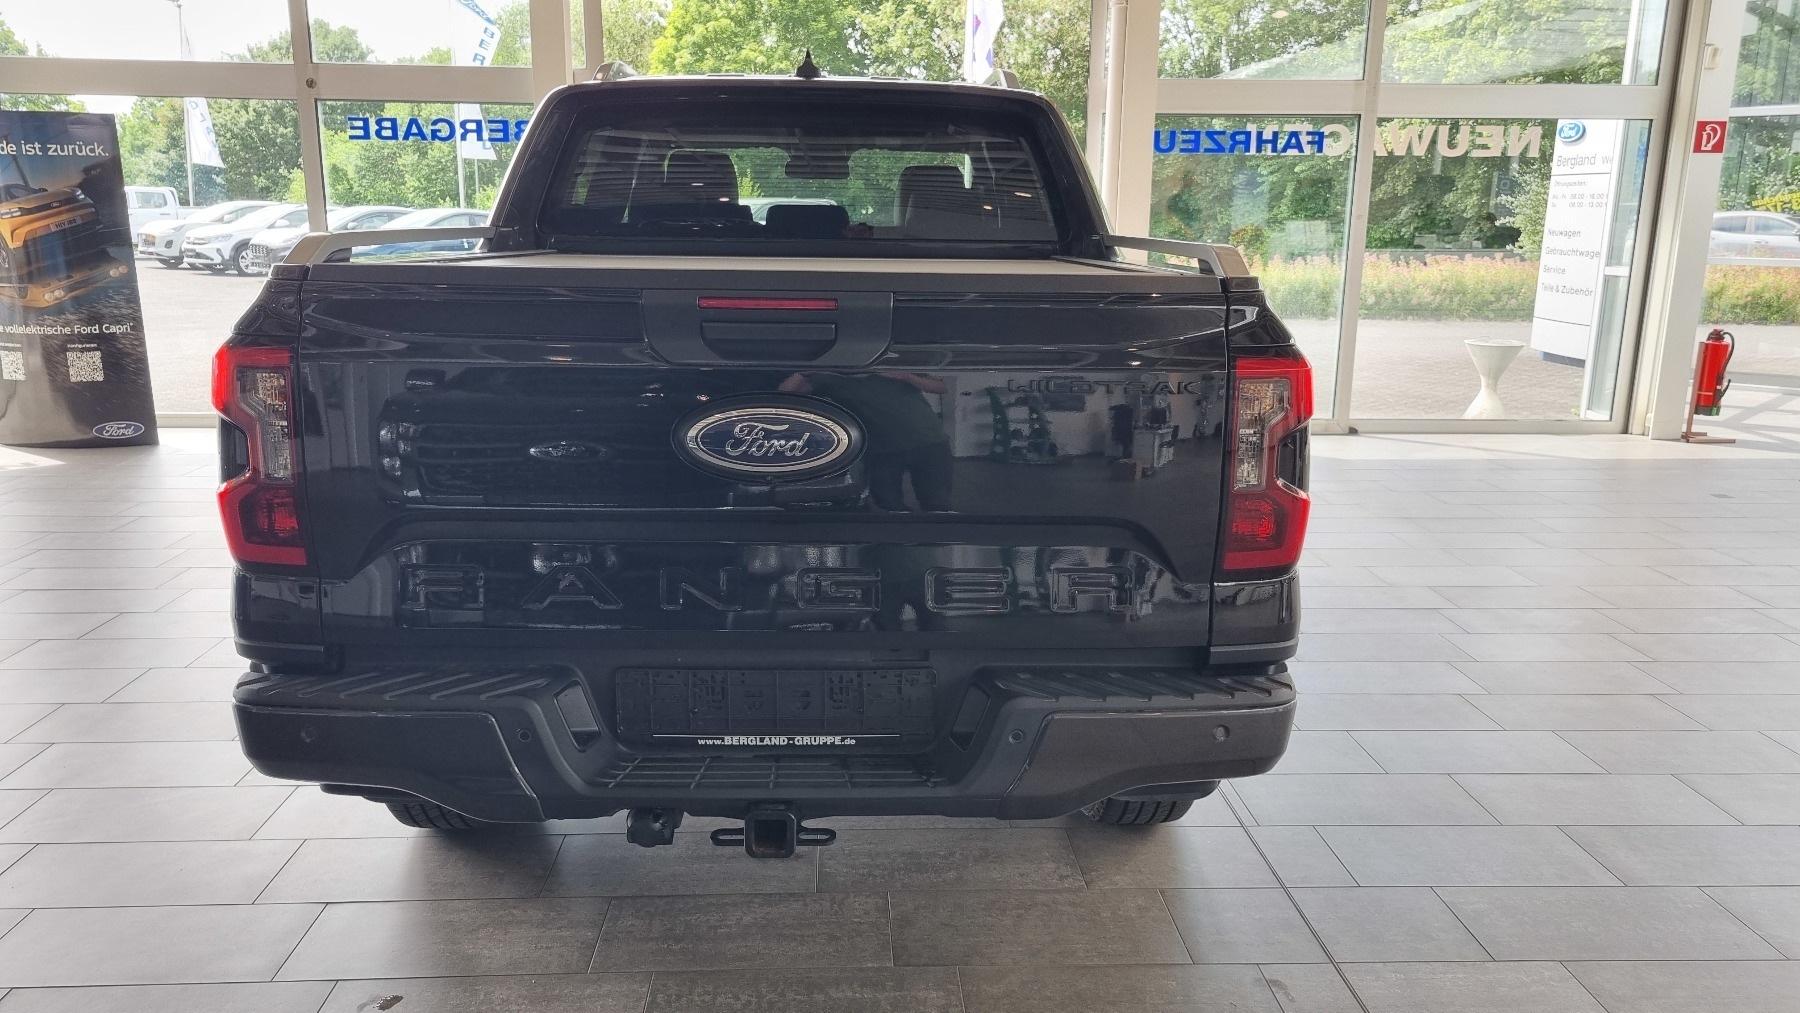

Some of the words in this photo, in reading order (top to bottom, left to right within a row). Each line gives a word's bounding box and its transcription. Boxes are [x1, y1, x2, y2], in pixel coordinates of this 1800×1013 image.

[21, 140, 42, 155] ist
[47, 141, 109, 156] zurück.
[1556, 153, 1597, 169] Bergland
[1543, 264, 1566, 274] Service
[1561, 284, 1593, 296] Zubehör
[5, 324, 71, 335] vollelektrische
[75, 324, 99, 334] Ford
[725, 422, 810, 457] Ford
[399, 562, 1134, 614] RANGER
